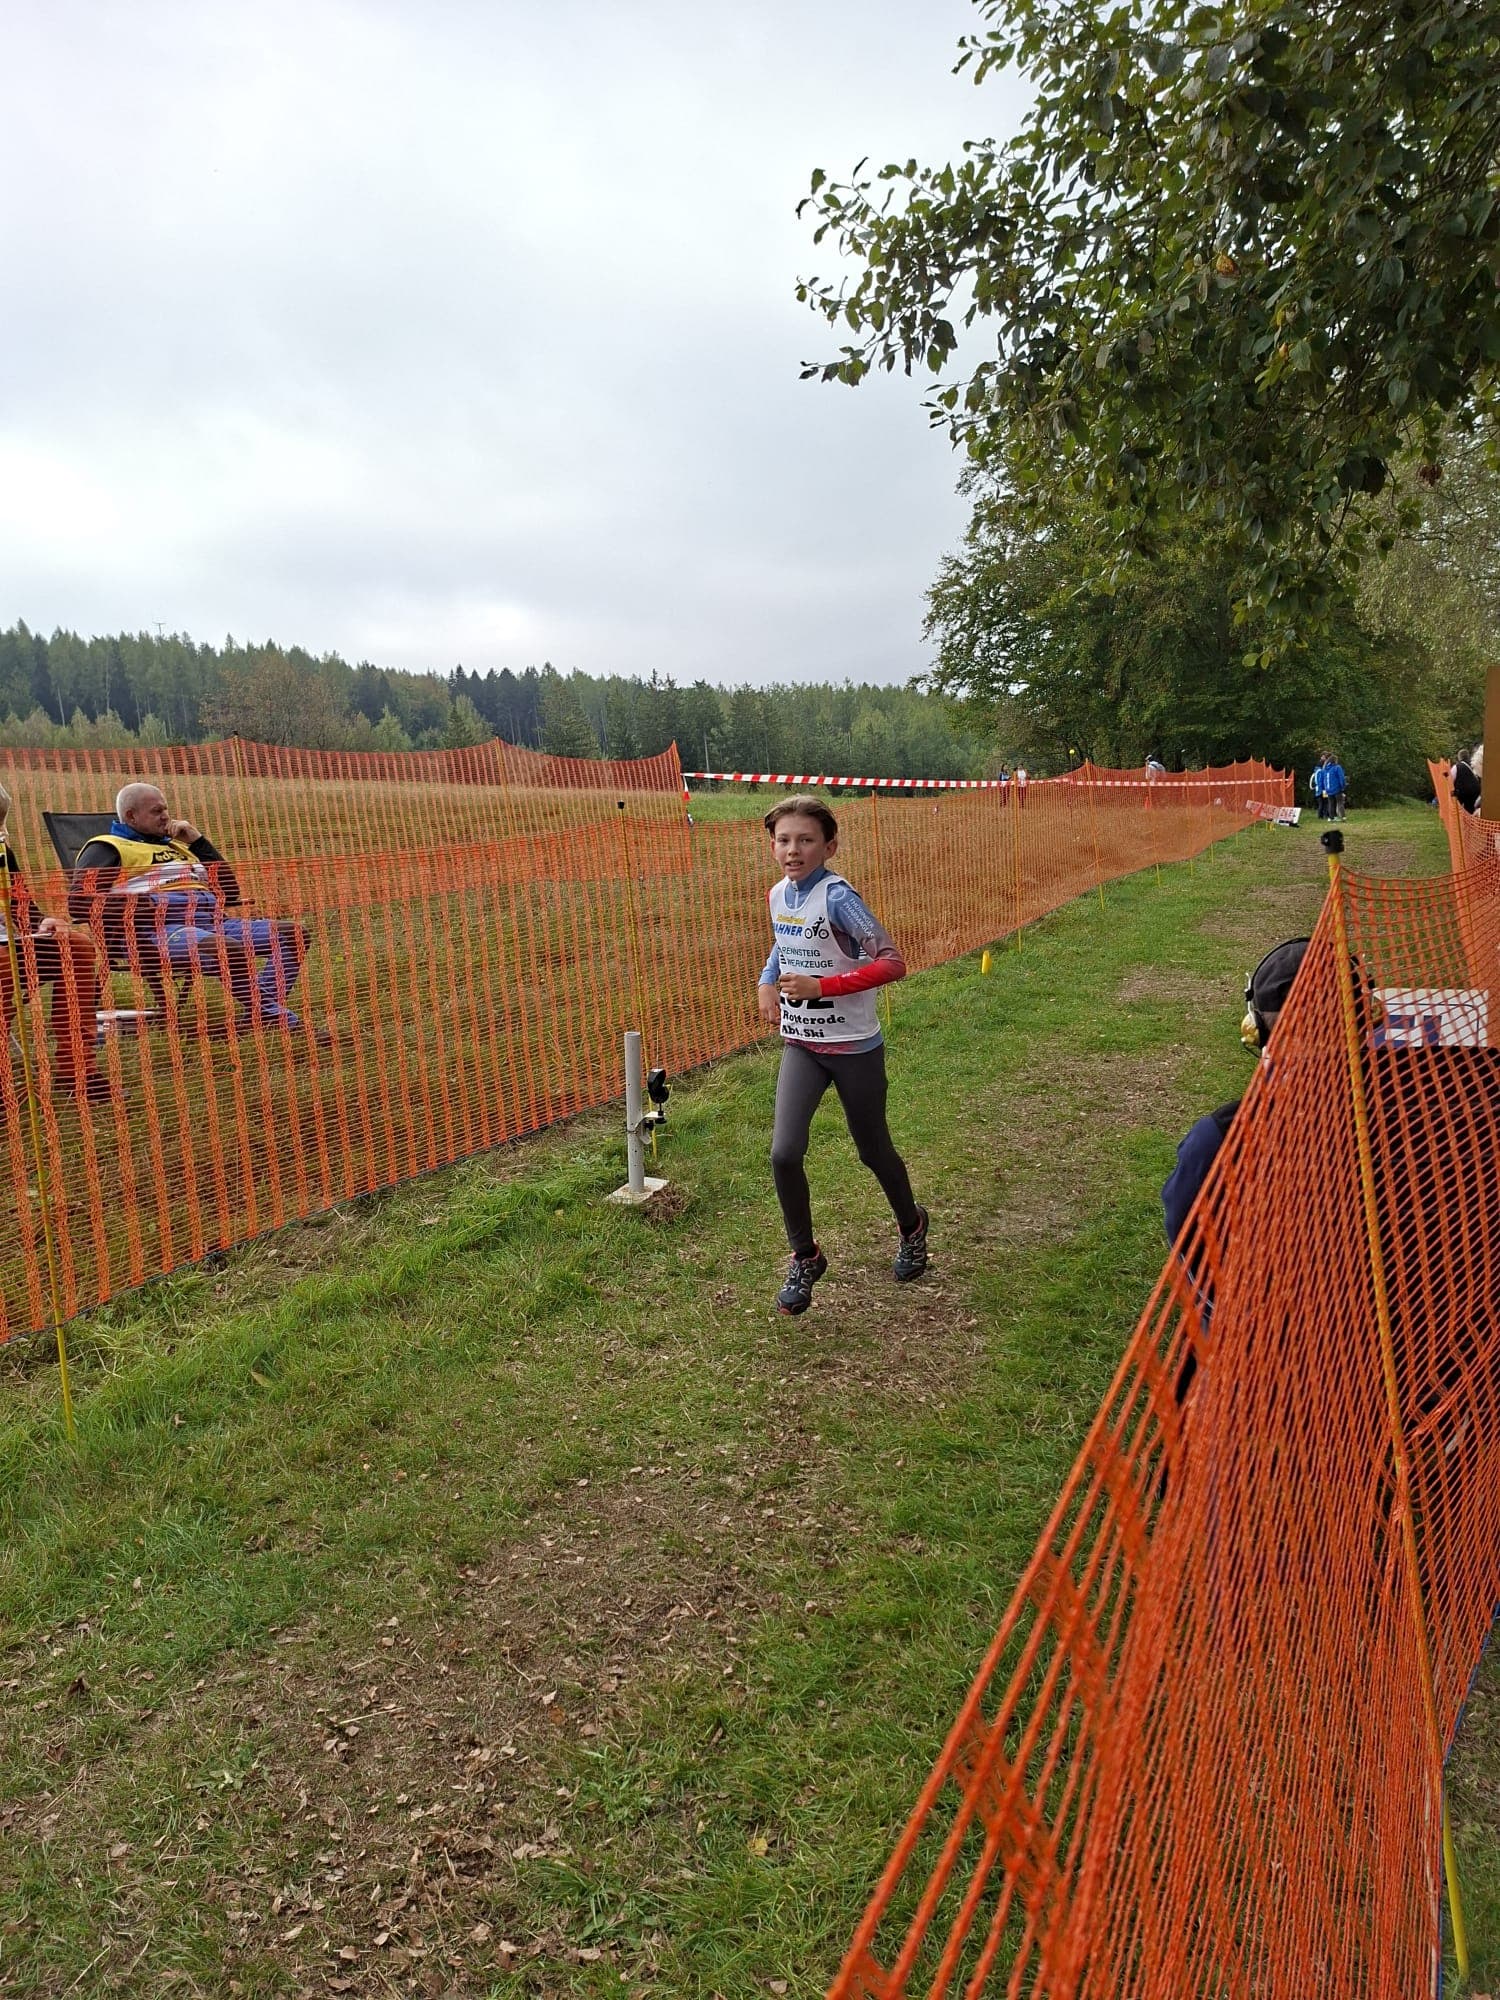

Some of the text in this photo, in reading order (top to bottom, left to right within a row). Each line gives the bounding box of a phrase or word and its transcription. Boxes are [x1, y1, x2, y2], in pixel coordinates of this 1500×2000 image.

[781, 946, 821, 957] RENNSTEIG
[786, 958, 834, 968] WERKZEUGE
[782, 1010, 845, 1024] Rotterode
